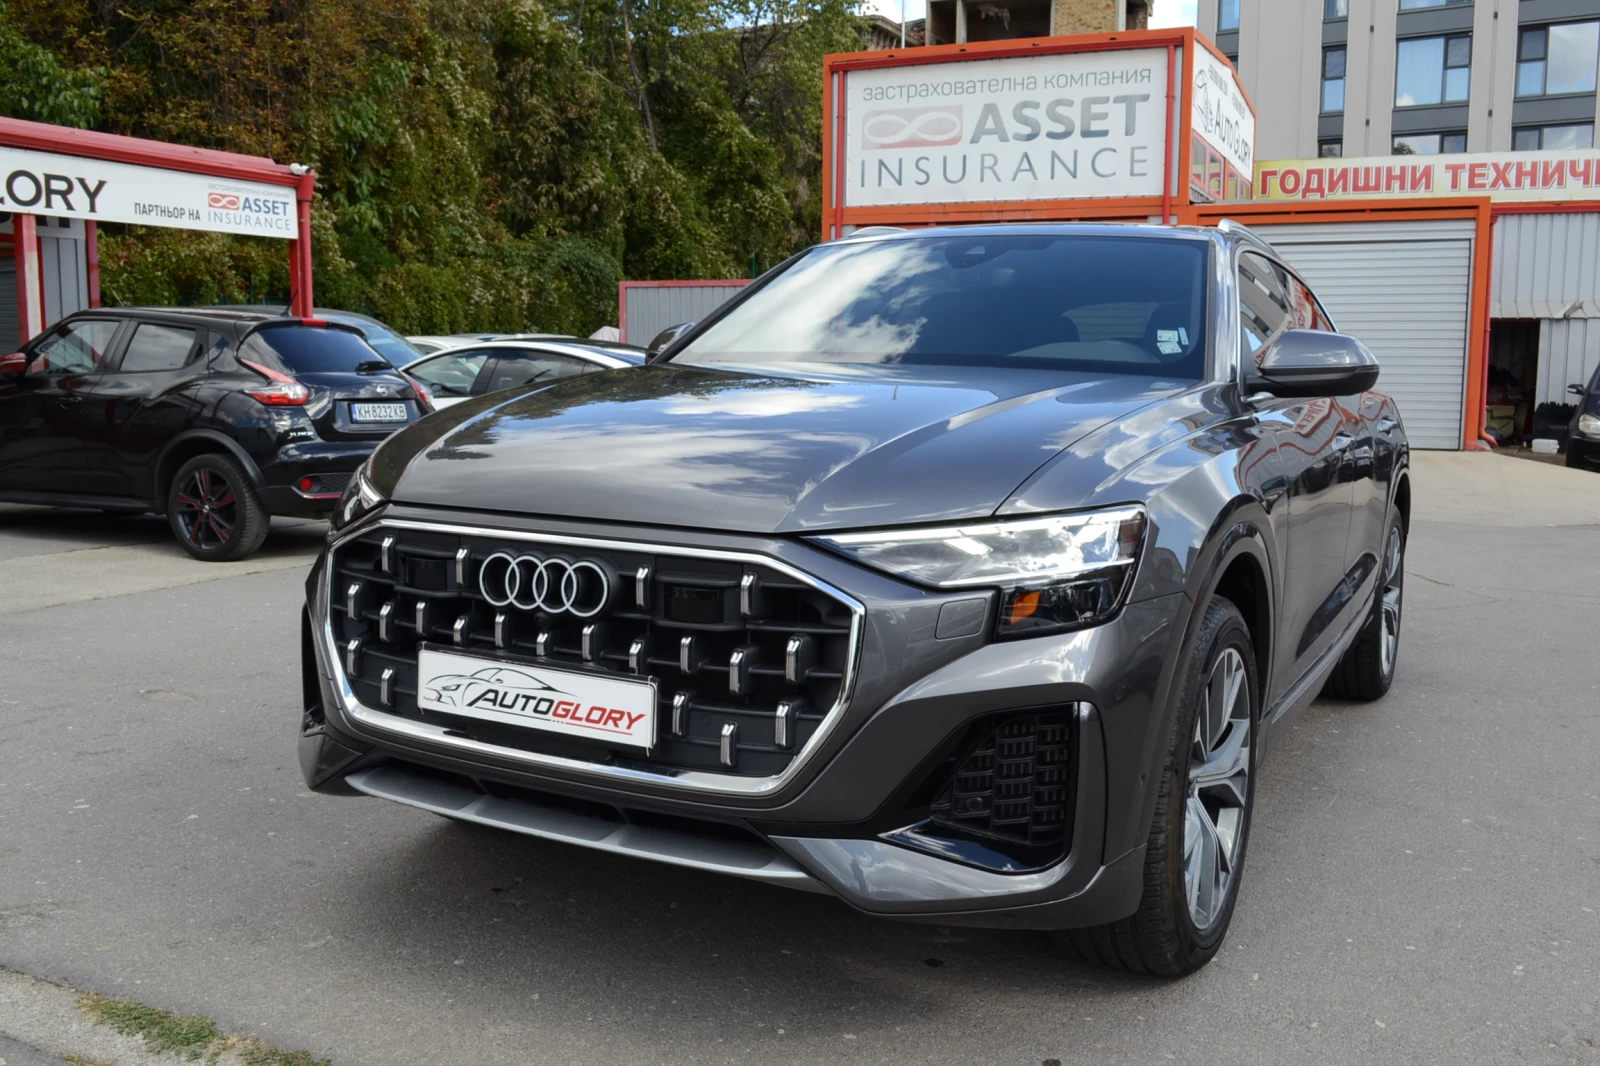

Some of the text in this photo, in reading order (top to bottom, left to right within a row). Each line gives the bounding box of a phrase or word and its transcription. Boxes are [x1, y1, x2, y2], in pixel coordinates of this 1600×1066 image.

[863, 68, 1152, 103] застрахователна компания
[969, 93, 1151, 145] ASSET
[860, 146, 1149, 188] INSURANCE
[1260, 164, 1434, 199] ГОДИШНИ
[0, 169, 107, 213] ORY
[242, 197, 290, 216] ASSET
[134, 202, 201, 221] ПАРТНЬОР НА
[207, 210, 291, 231] INSURANCE
[466, 688, 647, 730] AUTOGLORY
